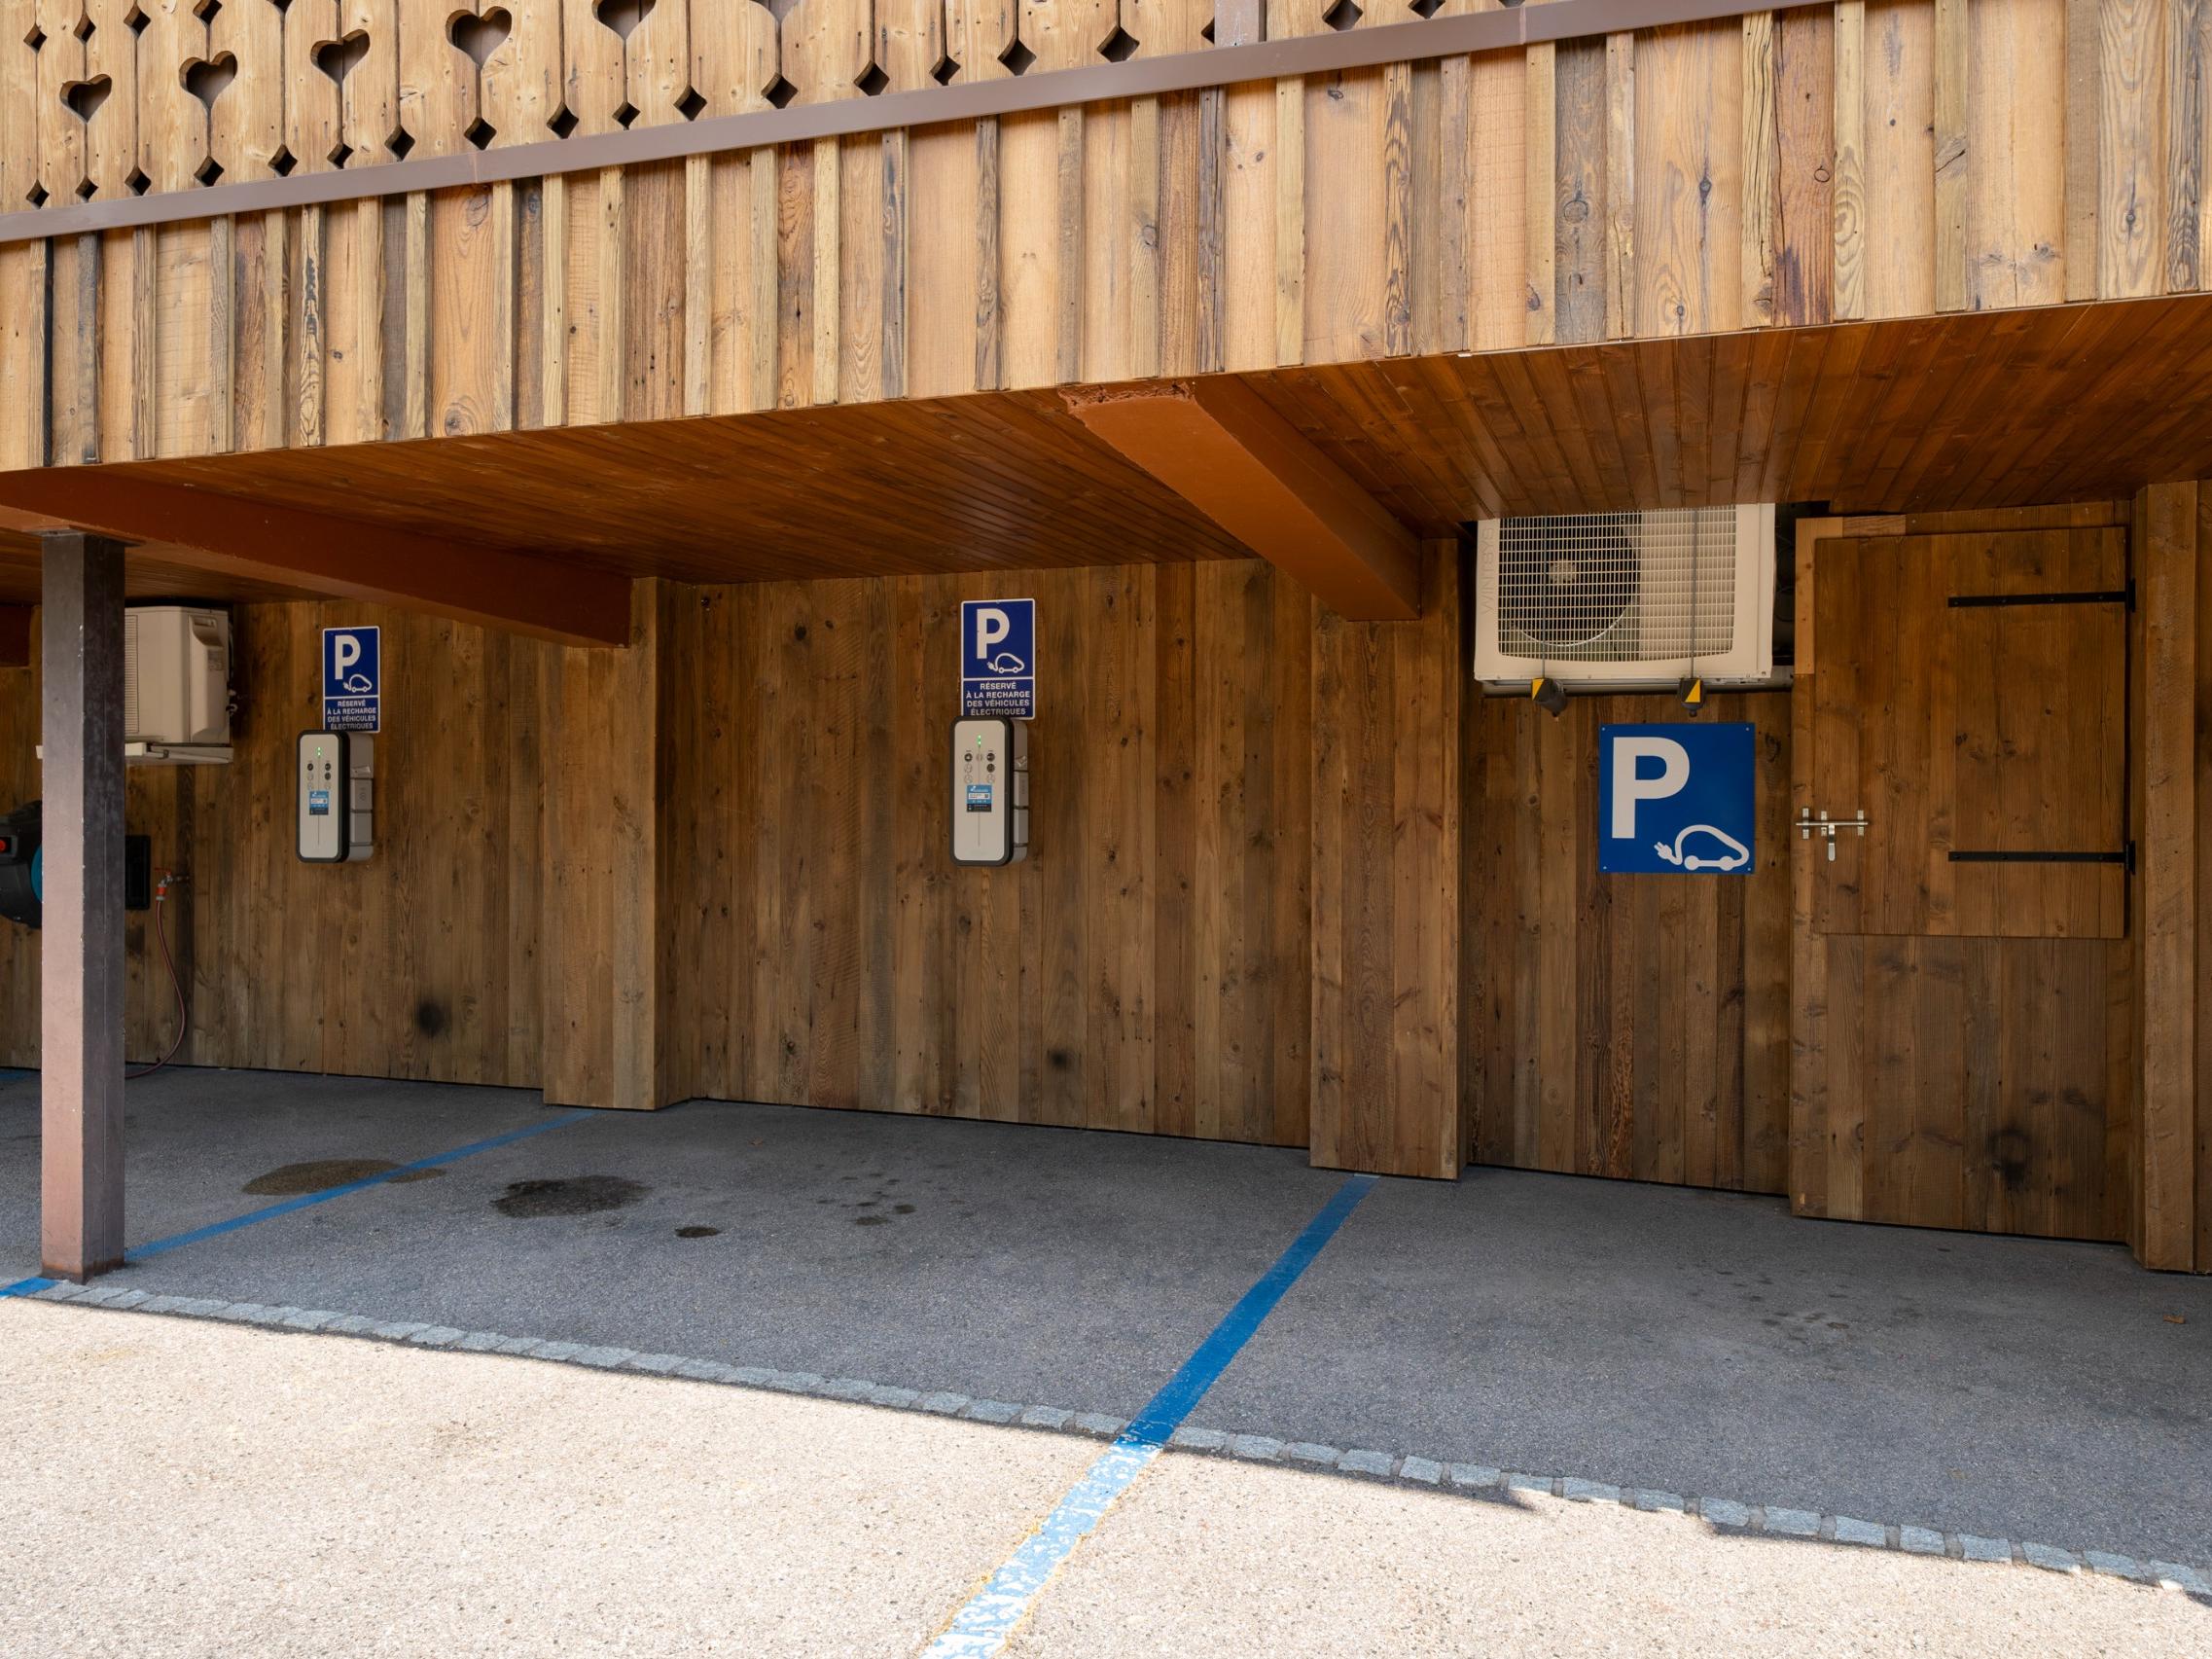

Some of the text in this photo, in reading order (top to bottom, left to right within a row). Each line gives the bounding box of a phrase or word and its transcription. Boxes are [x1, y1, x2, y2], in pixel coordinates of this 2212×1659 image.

[977, 608, 1010, 659] P
[335, 634, 361, 679] P
[966, 690, 972, 699] À
[986, 690, 1030, 699] RECHARGE
[980, 681, 1017, 690] RÉSERVÉ
[1612, 737, 1691, 839] P
